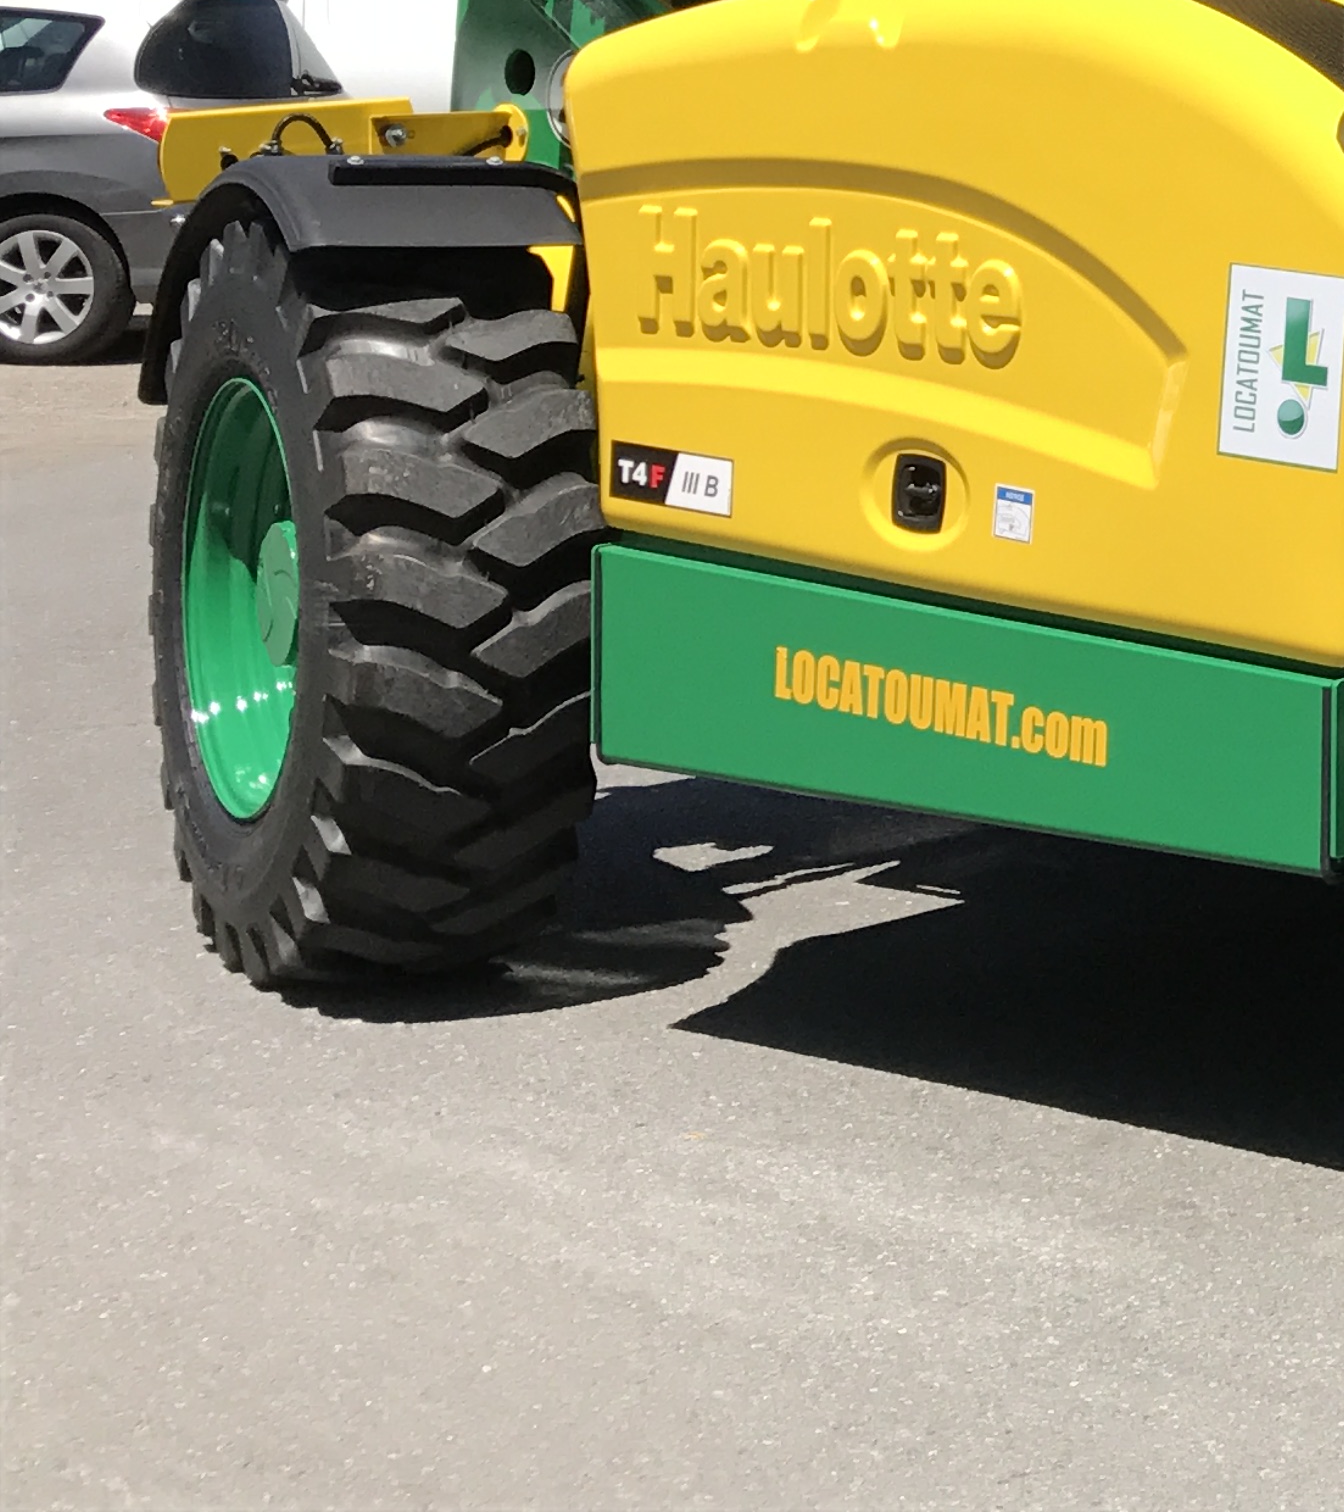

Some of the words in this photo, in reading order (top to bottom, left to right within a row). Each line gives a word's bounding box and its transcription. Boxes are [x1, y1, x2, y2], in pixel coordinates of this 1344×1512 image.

[638, 203, 1022, 370] Haulotte
[1233, 289, 1264, 433] LOCATOUMAT
[617, 458, 666, 488] T4F
[703, 474, 719, 498] B
[774, 646, 1107, 767] LOCATOUMAT.com
